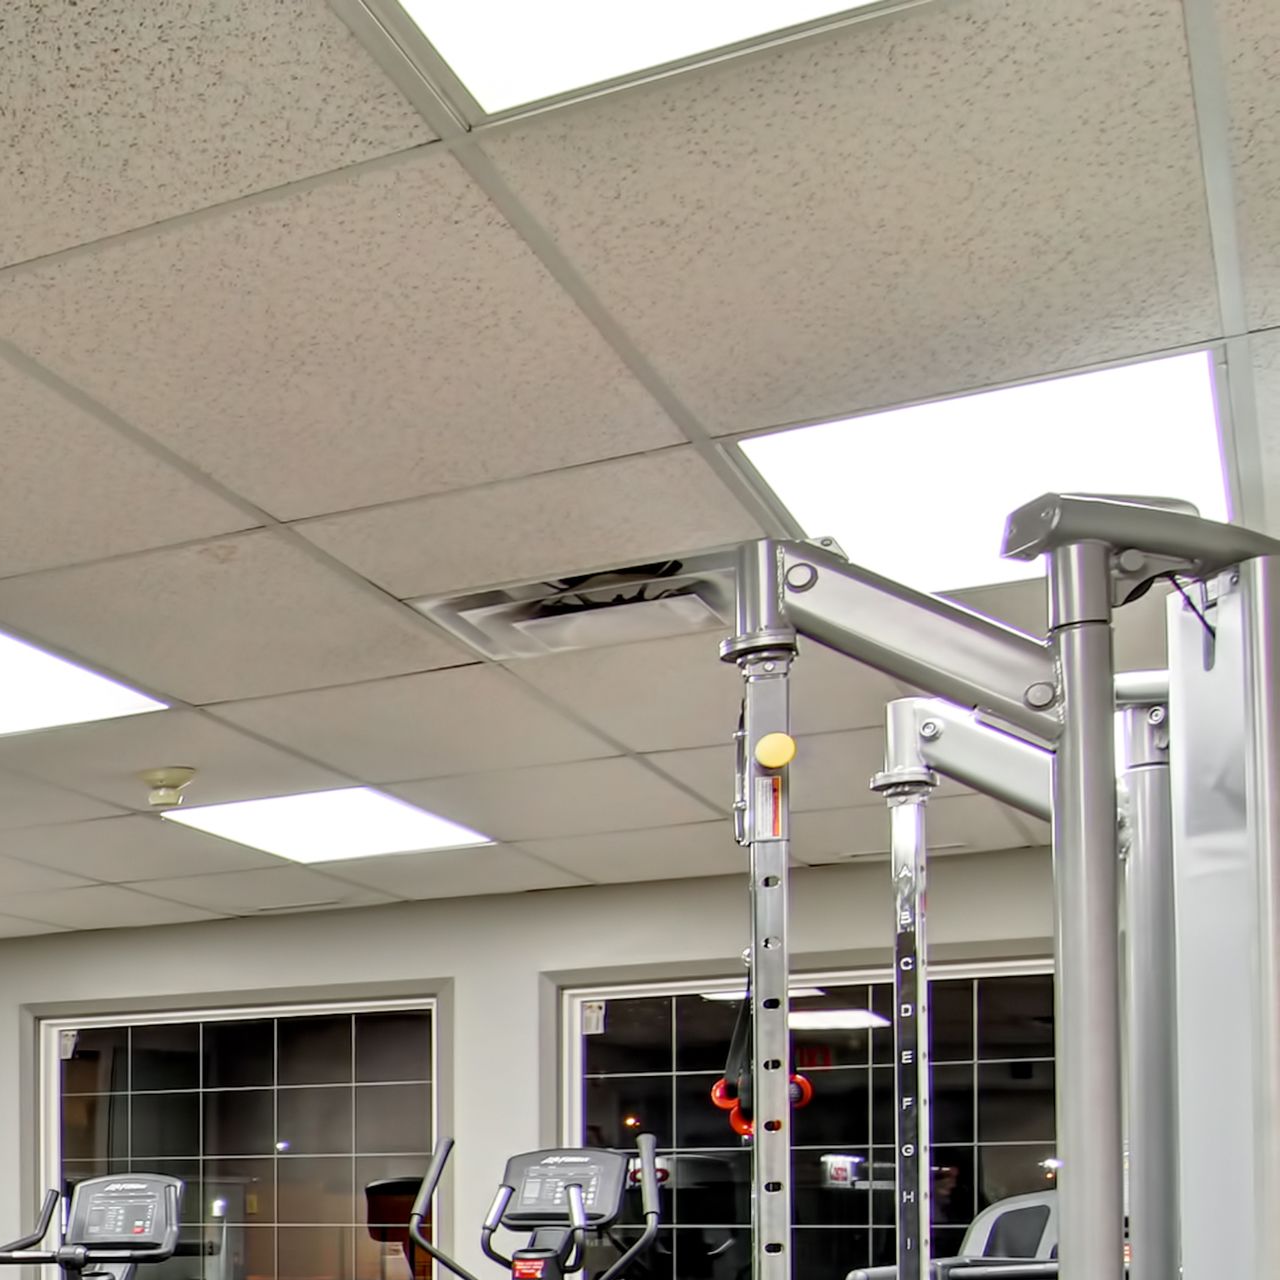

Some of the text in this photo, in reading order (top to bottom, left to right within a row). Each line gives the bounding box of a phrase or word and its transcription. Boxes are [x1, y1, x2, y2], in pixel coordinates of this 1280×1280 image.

[899, 866, 913, 878] A
[900, 911, 913, 924] B
[900, 957, 913, 970] C
[900, 1004, 913, 1017] D
[901, 1050, 913, 1064] E
[902, 1097, 913, 1110] F
[901, 1144, 915, 1156] G
[902, 1191, 915, 1203] H
